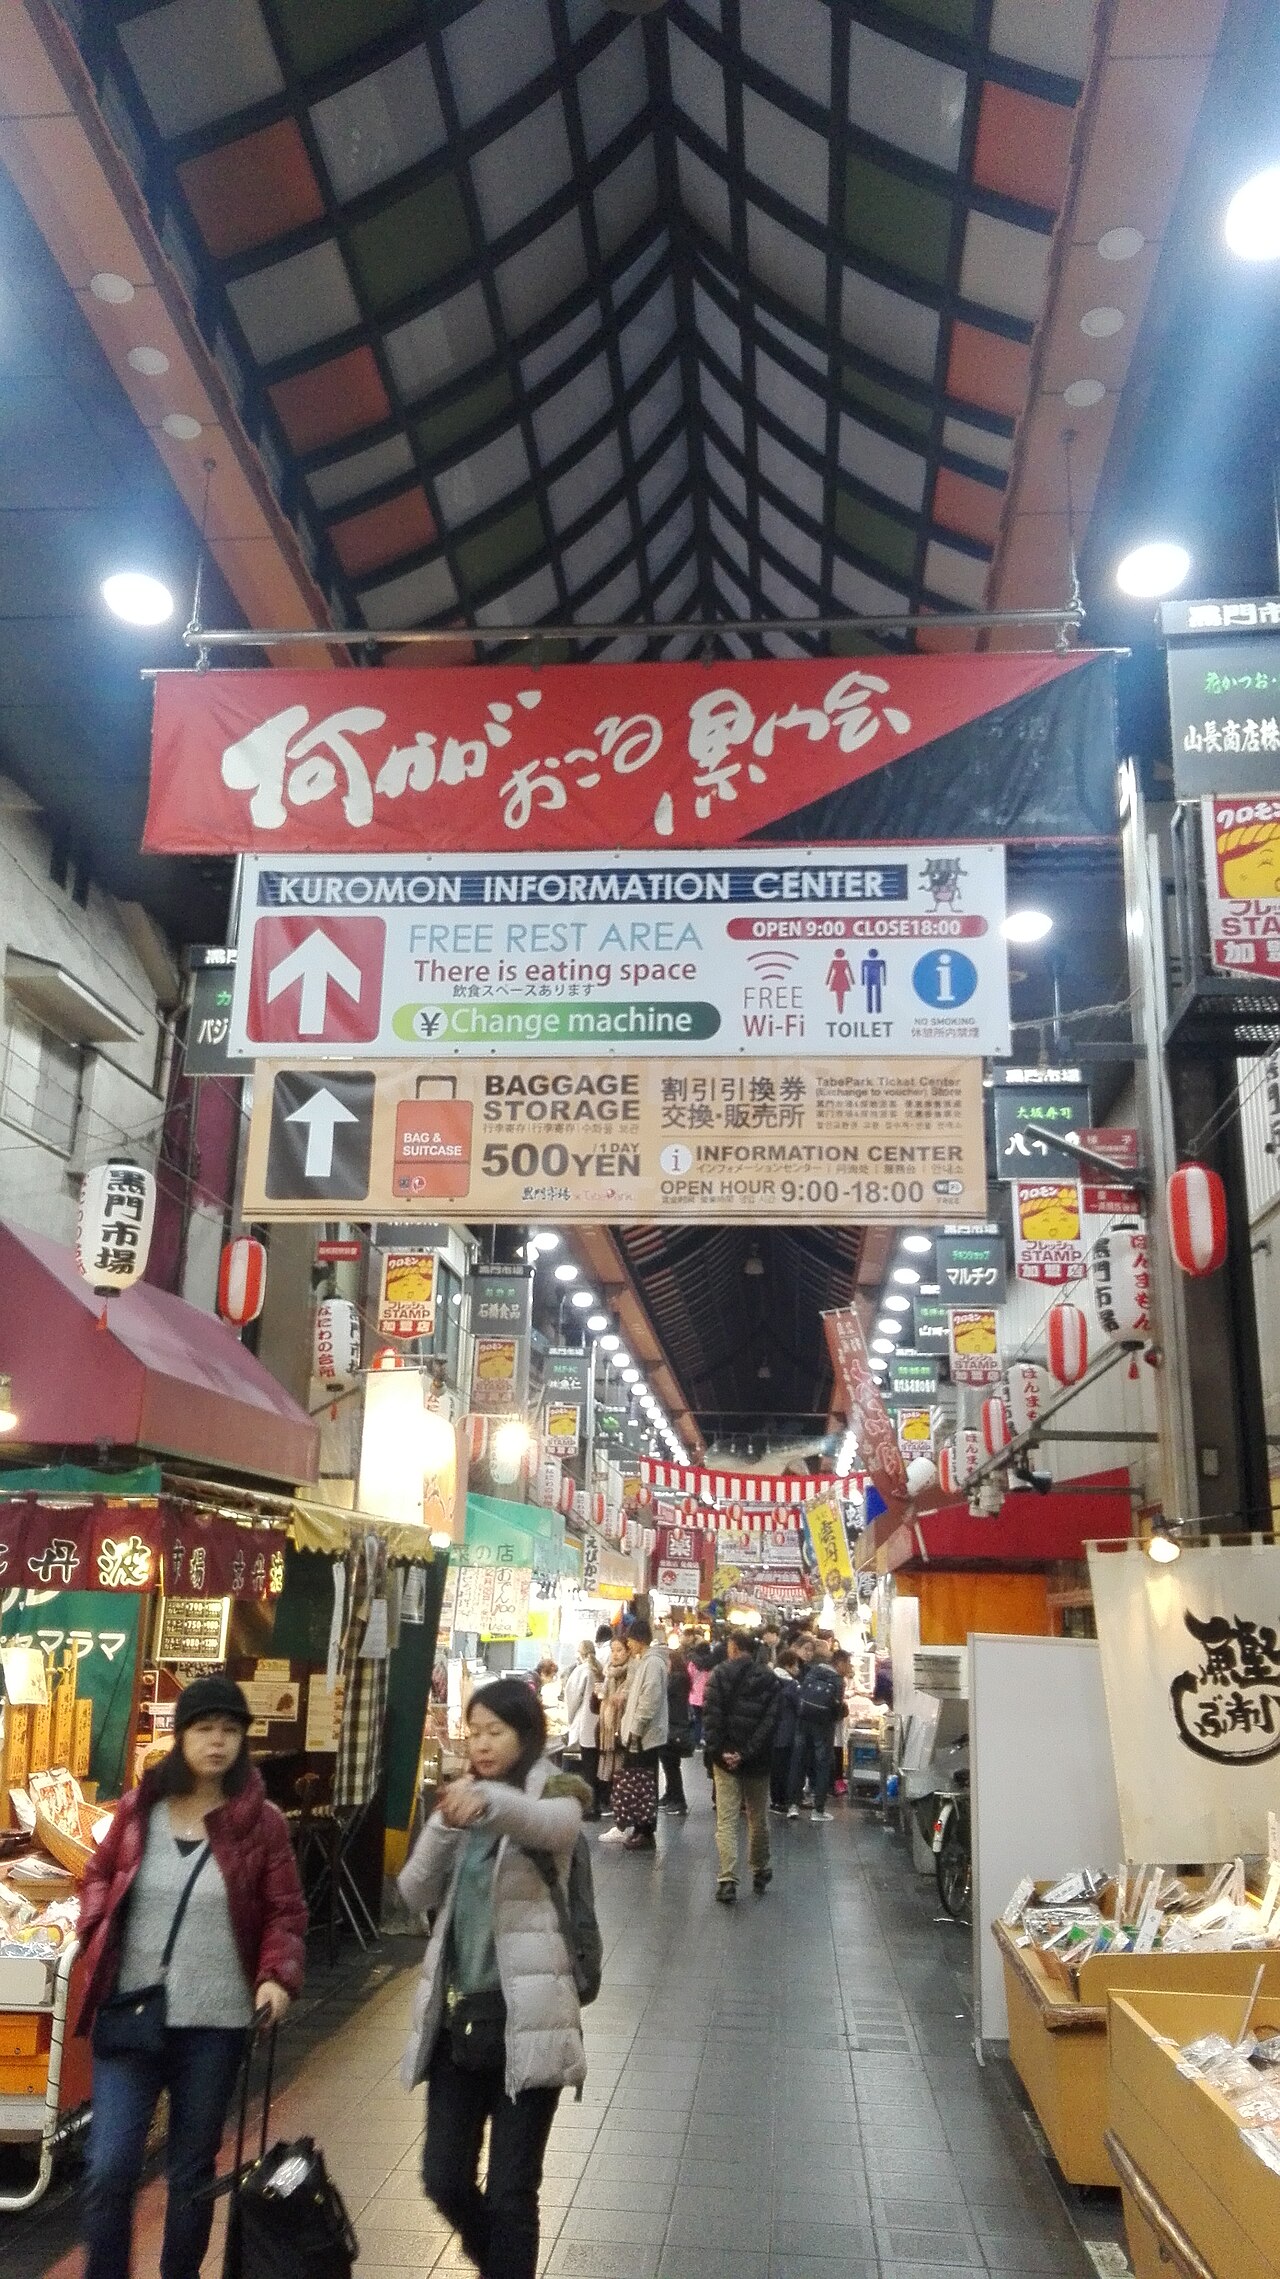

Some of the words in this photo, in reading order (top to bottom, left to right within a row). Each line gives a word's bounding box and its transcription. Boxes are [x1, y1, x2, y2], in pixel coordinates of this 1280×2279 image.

[279, 877, 462, 904] KUROMON
[484, 873, 731, 902] INFORMATION
[752, 871, 884, 899] CENTER
[409, 924, 494, 953] FREE
[507, 922, 587, 952] REST
[599, 921, 703, 952] AREA
[752, 922, 802, 937] OPEN
[805, 921, 845, 936] 9:00
[414, 960, 490, 982] There
[498, 959, 516, 982] is
[525, 959, 613, 986] eating
[619, 963, 697, 985] space
[452, 984, 595, 998] 飲食スペースあります
[743, 987, 802, 1009] FREE
[451, 1008, 560, 1039] Change
[568, 1008, 692, 1033] machine
[743, 1014, 805, 1037] Wi-Fi
[826, 1022, 894, 1038] TOILET
[914, 1017, 928, 1026] NO
[931, 1017, 976, 1026] SMOKING
[484, 1074, 640, 1096] BAGGAGE
[661, 1076, 806, 1101] 割引引換券
[483, 1100, 640, 1121] STORAGE
[661, 1103, 806, 1129] 交換・販売所
[403, 1133, 430, 1144] BAG
[431, 1133, 442, 1144] &
[402, 1145, 463, 1157] SUITCASE
[696, 1146, 858, 1161] INFORMATION
[867, 1146, 963, 1161] CENTER
[660, 1180, 713, 1195] OPEN
[720, 1180, 776, 1195] HOUR
[781, 1179, 924, 1203] 9:00-18:00
[94, 1169, 147, 1275] 黒門市場
[1021, 1250, 1082, 1263] STAMP
[945, 1267, 999, 1286] マルチク
[383, 1309, 430, 1319] STAMP
[954, 1360, 998, 1369] STAMP
[0, 1535, 152, 1587] 丹波
[584, 1535, 598, 1592] えびかに
